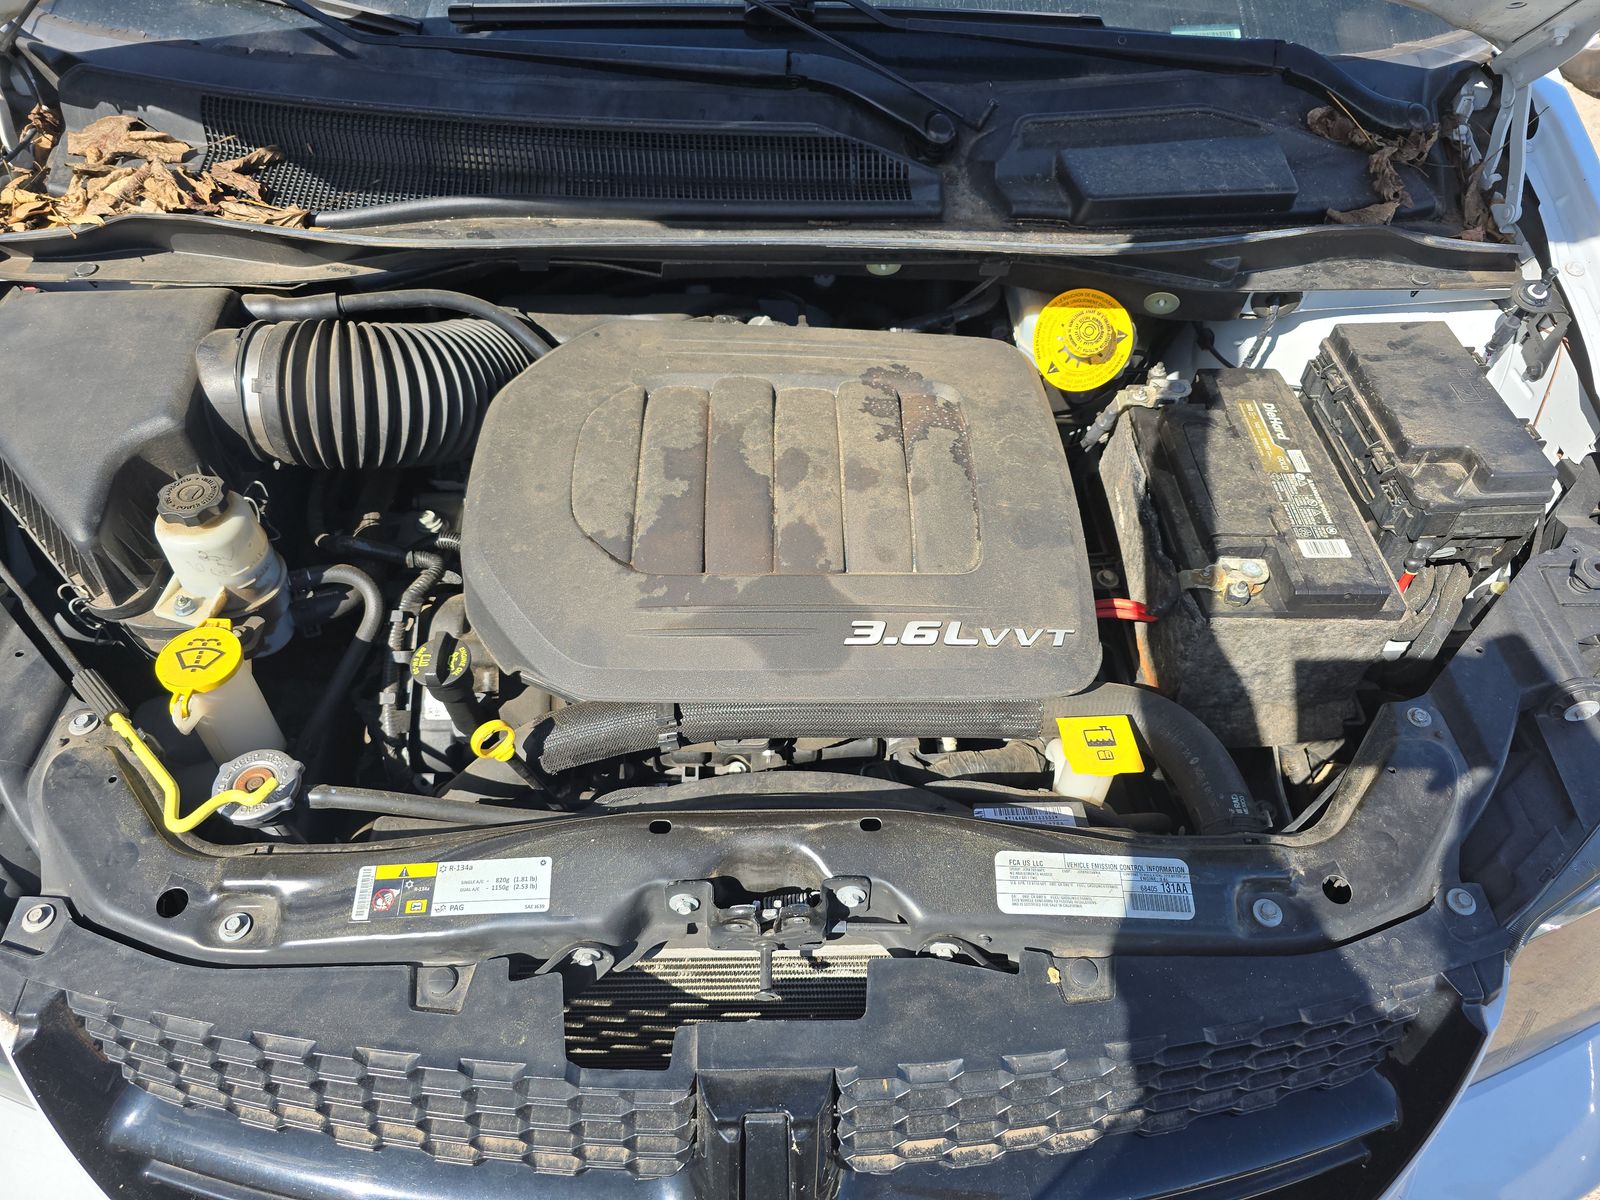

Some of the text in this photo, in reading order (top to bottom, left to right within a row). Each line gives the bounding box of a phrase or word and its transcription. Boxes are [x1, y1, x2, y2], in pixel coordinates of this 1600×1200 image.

[1262, 402, 1290, 441] DieHard
[1276, 455, 1290, 471] GOLD
[843, 620, 1077, 648] 3.6L VVT
[451, 646, 468, 676] ENGINE OIL
[449, 864, 473, 872] R-134a
[1066, 861, 1089, 869] VEHICLE
[1091, 862, 1118, 870] EMISSION
[1146, 865, 1185, 873] INFORMATION
[1140, 882, 1189, 893] 68405 131AA
